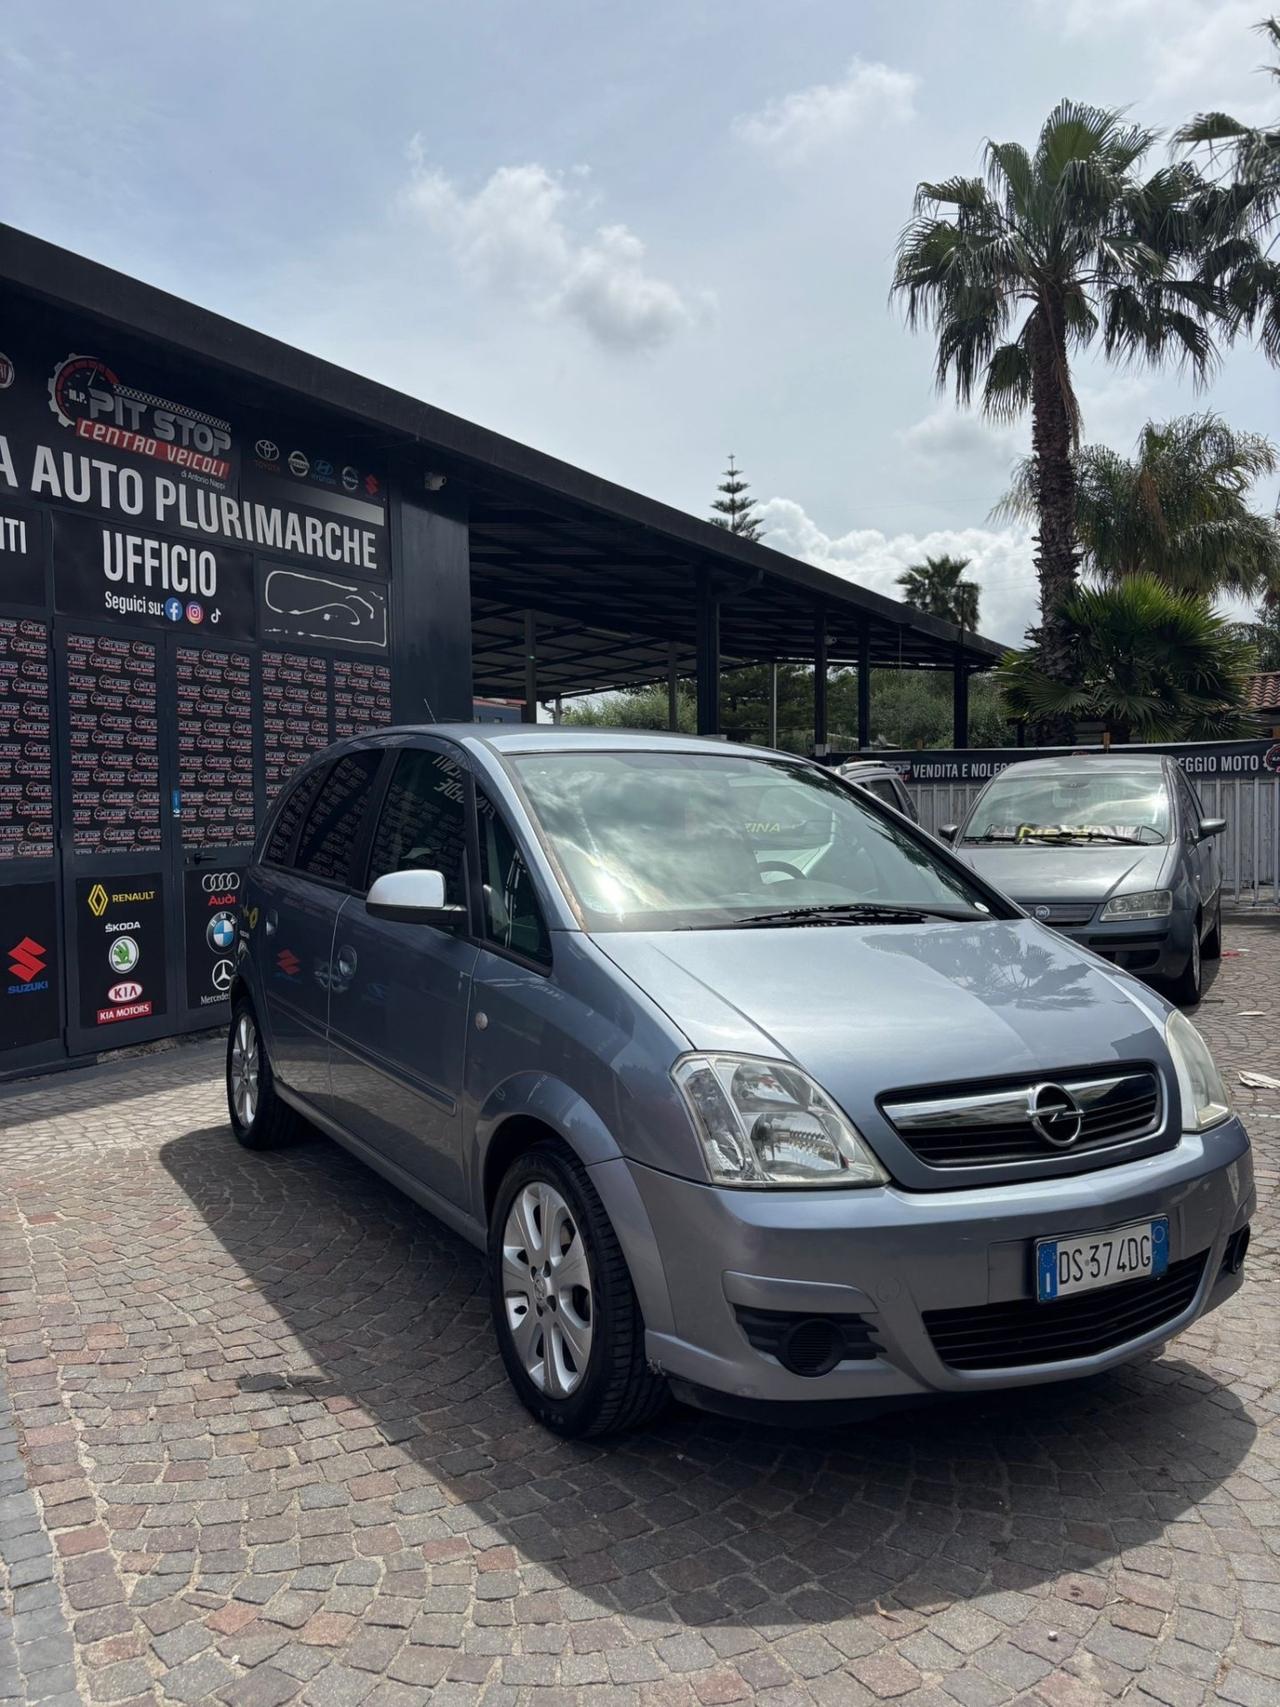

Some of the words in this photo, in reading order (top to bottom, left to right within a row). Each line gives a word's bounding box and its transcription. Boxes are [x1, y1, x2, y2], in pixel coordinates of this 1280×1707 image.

[88, 387, 148, 431] PIT
[152, 410, 232, 457] STOP
[31, 445, 144, 516] AUTO
[156, 477, 377, 570] PLURIMARCHE
[103, 530, 217, 597] UFFICIO
[105, 591, 146, 614] Seguici
[148, 601, 165, 616] su:
[912, 763, 958, 778] VENDITA
[962, 763, 968, 777] E
[1221, 755, 1259, 771] MOTO
[112, 890, 156, 903] RENAULT
[105, 921, 141, 933] ŠKODA
[8, 980, 48, 994] SUZUKI
[113, 984, 137, 998] KIA
[100, 1010, 114, 1020] KIA
[116, 1004, 149, 1018] MOTORS
